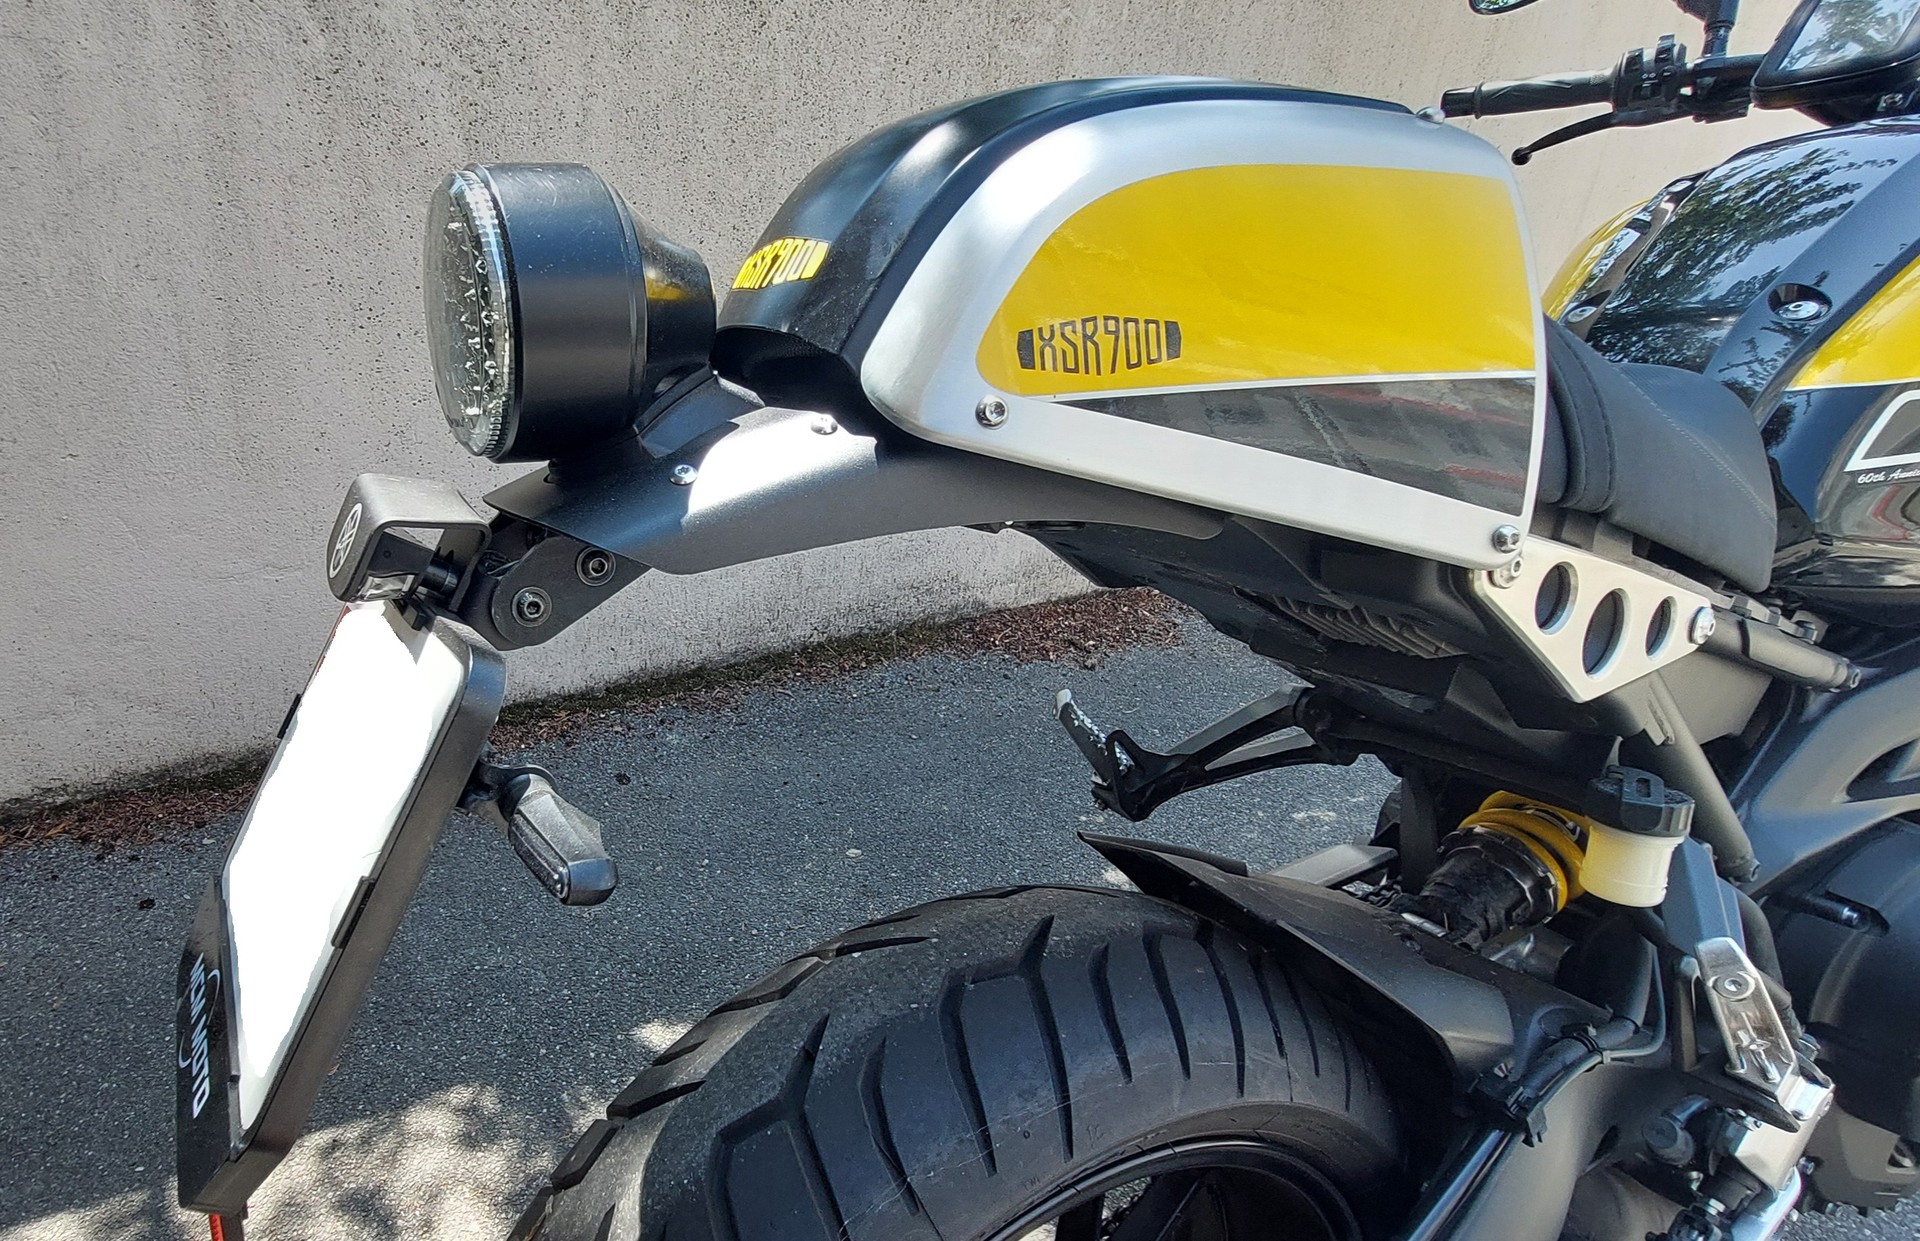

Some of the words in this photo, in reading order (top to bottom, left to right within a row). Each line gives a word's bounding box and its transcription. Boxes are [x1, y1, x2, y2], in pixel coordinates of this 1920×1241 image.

[1038, 315, 1162, 376] XSR900
[1857, 471, 1886, 484] 60th
[191, 1013, 211, 1119] MOTO
